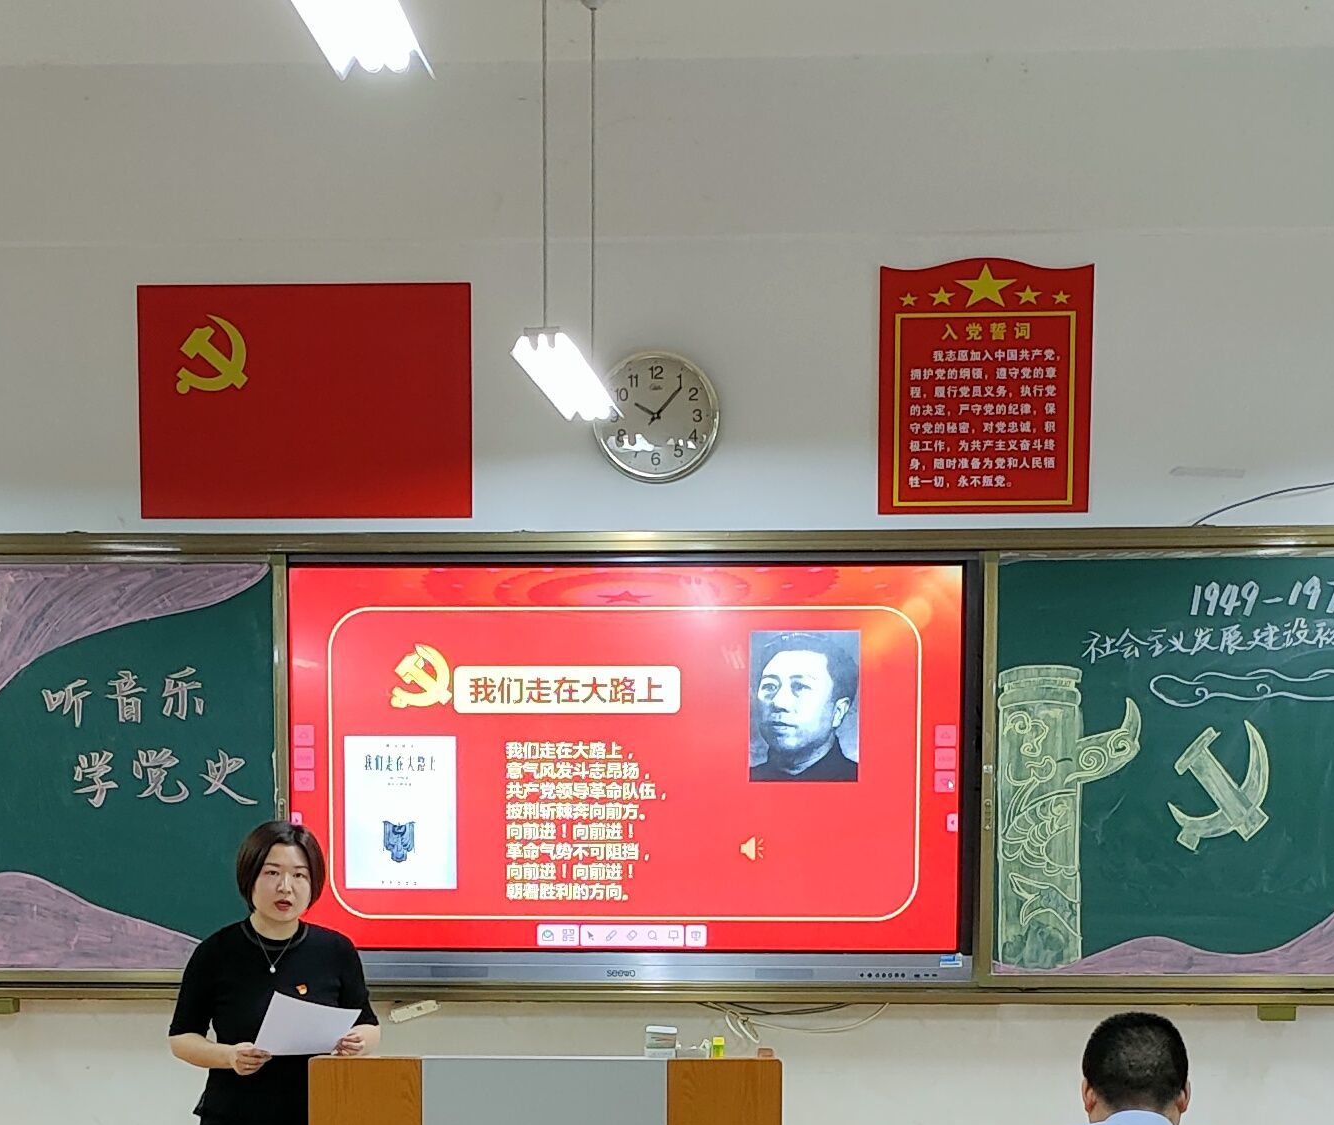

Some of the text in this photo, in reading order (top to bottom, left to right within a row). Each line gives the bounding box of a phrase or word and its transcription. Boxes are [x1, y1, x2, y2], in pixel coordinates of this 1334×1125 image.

[941, 321, 1032, 342] 入党誓词
[649, 365, 664, 380] 12
[628, 374, 639, 388] 11
[615, 387, 629, 402] 10
[688, 387, 699, 401] 2
[692, 410, 703, 423] 3
[688, 429, 699, 442] 4
[673, 444, 684, 458] 5
[650, 452, 661, 466] 6
[41, 665, 206, 729] 听音乐
[469, 676, 665, 705] 我们走在大路上
[72, 746, 259, 809] 学党史
